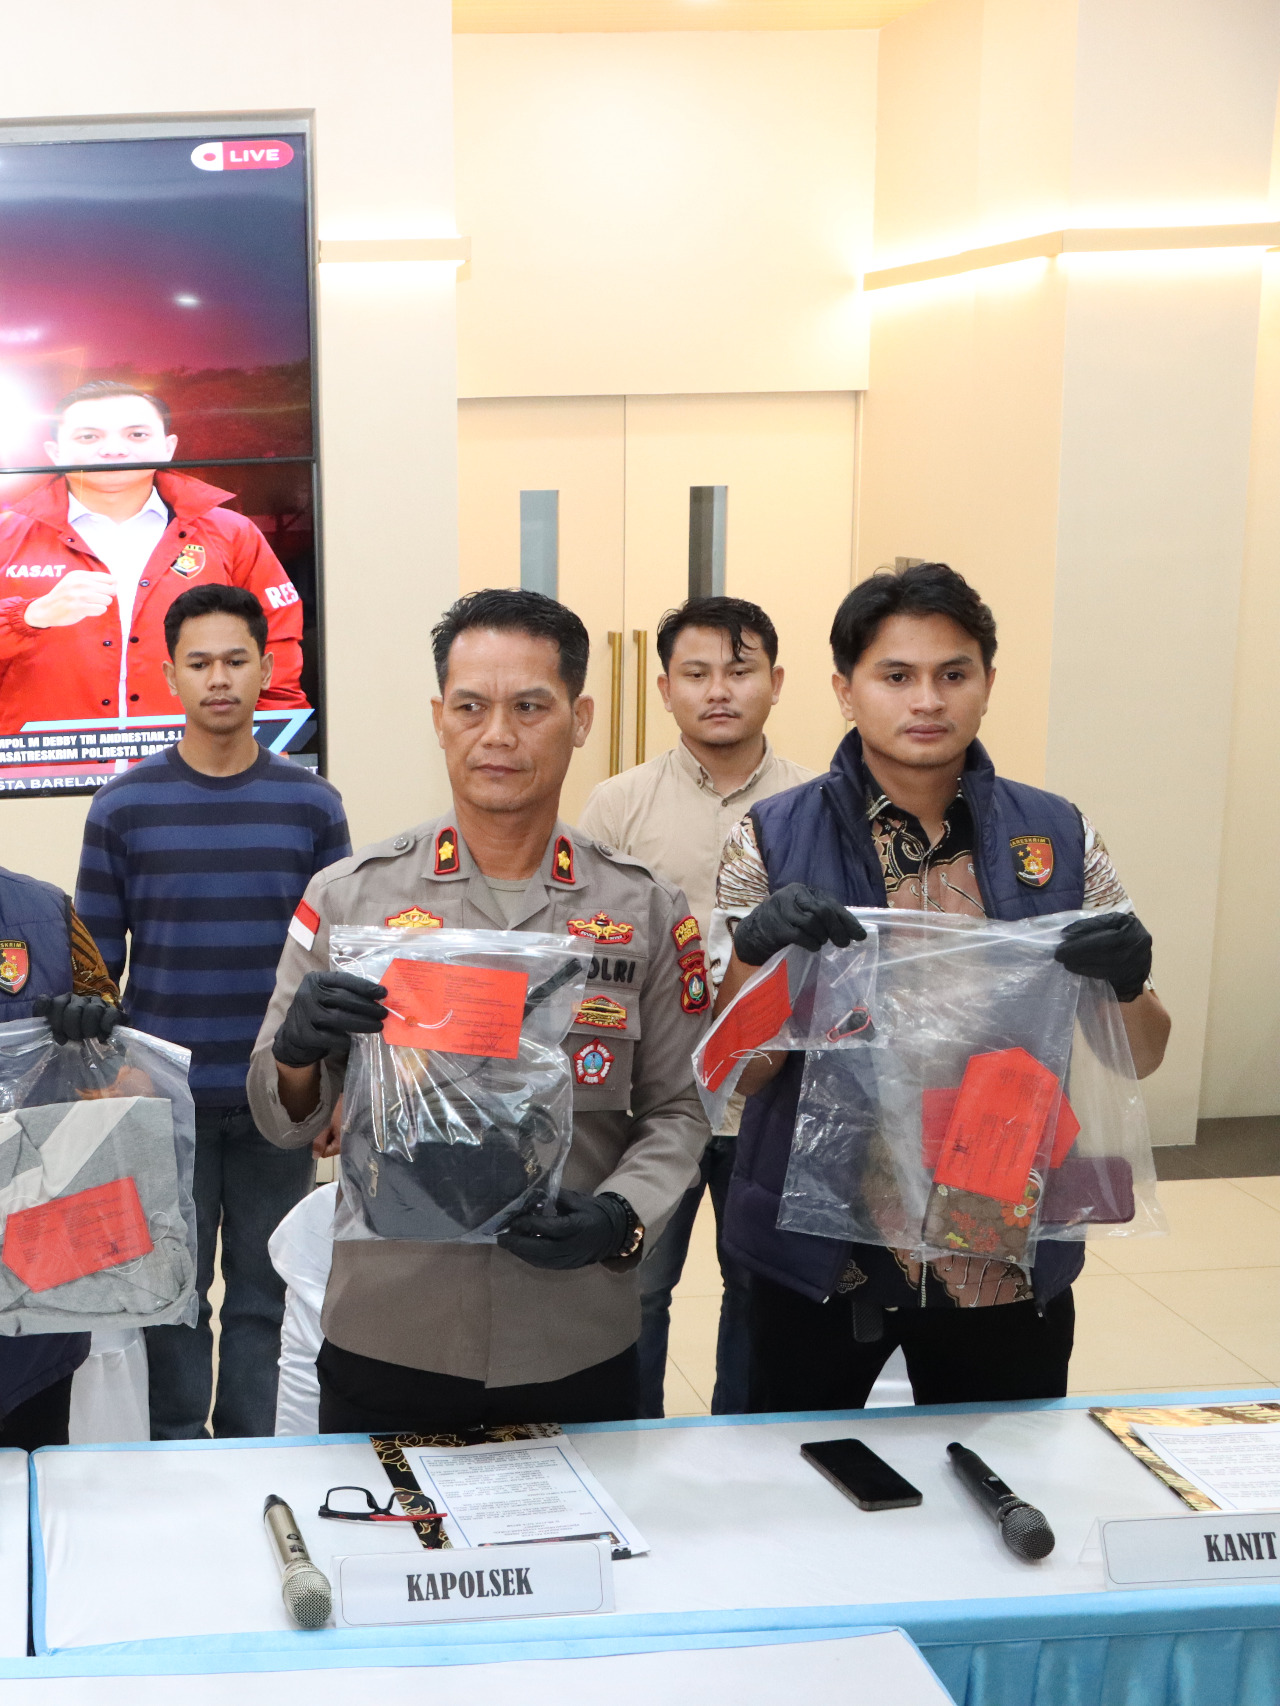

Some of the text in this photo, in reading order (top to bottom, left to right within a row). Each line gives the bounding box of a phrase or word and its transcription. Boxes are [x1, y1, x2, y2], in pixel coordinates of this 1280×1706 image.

[230, 149, 280, 162] LIVE
[5, 564, 66, 578] KASAT
[265, 582, 301, 609] RES
[28, 735, 40, 748] M
[43, 733, 77, 747] DEBBY
[79, 732, 97, 745] TRI
[81, 745, 138, 760] POLRESTA
[587, 956, 636, 983] OLRI
[1204, 1532, 1277, 1562] KANIT
[406, 1567, 533, 1601] KAPOLSEK
